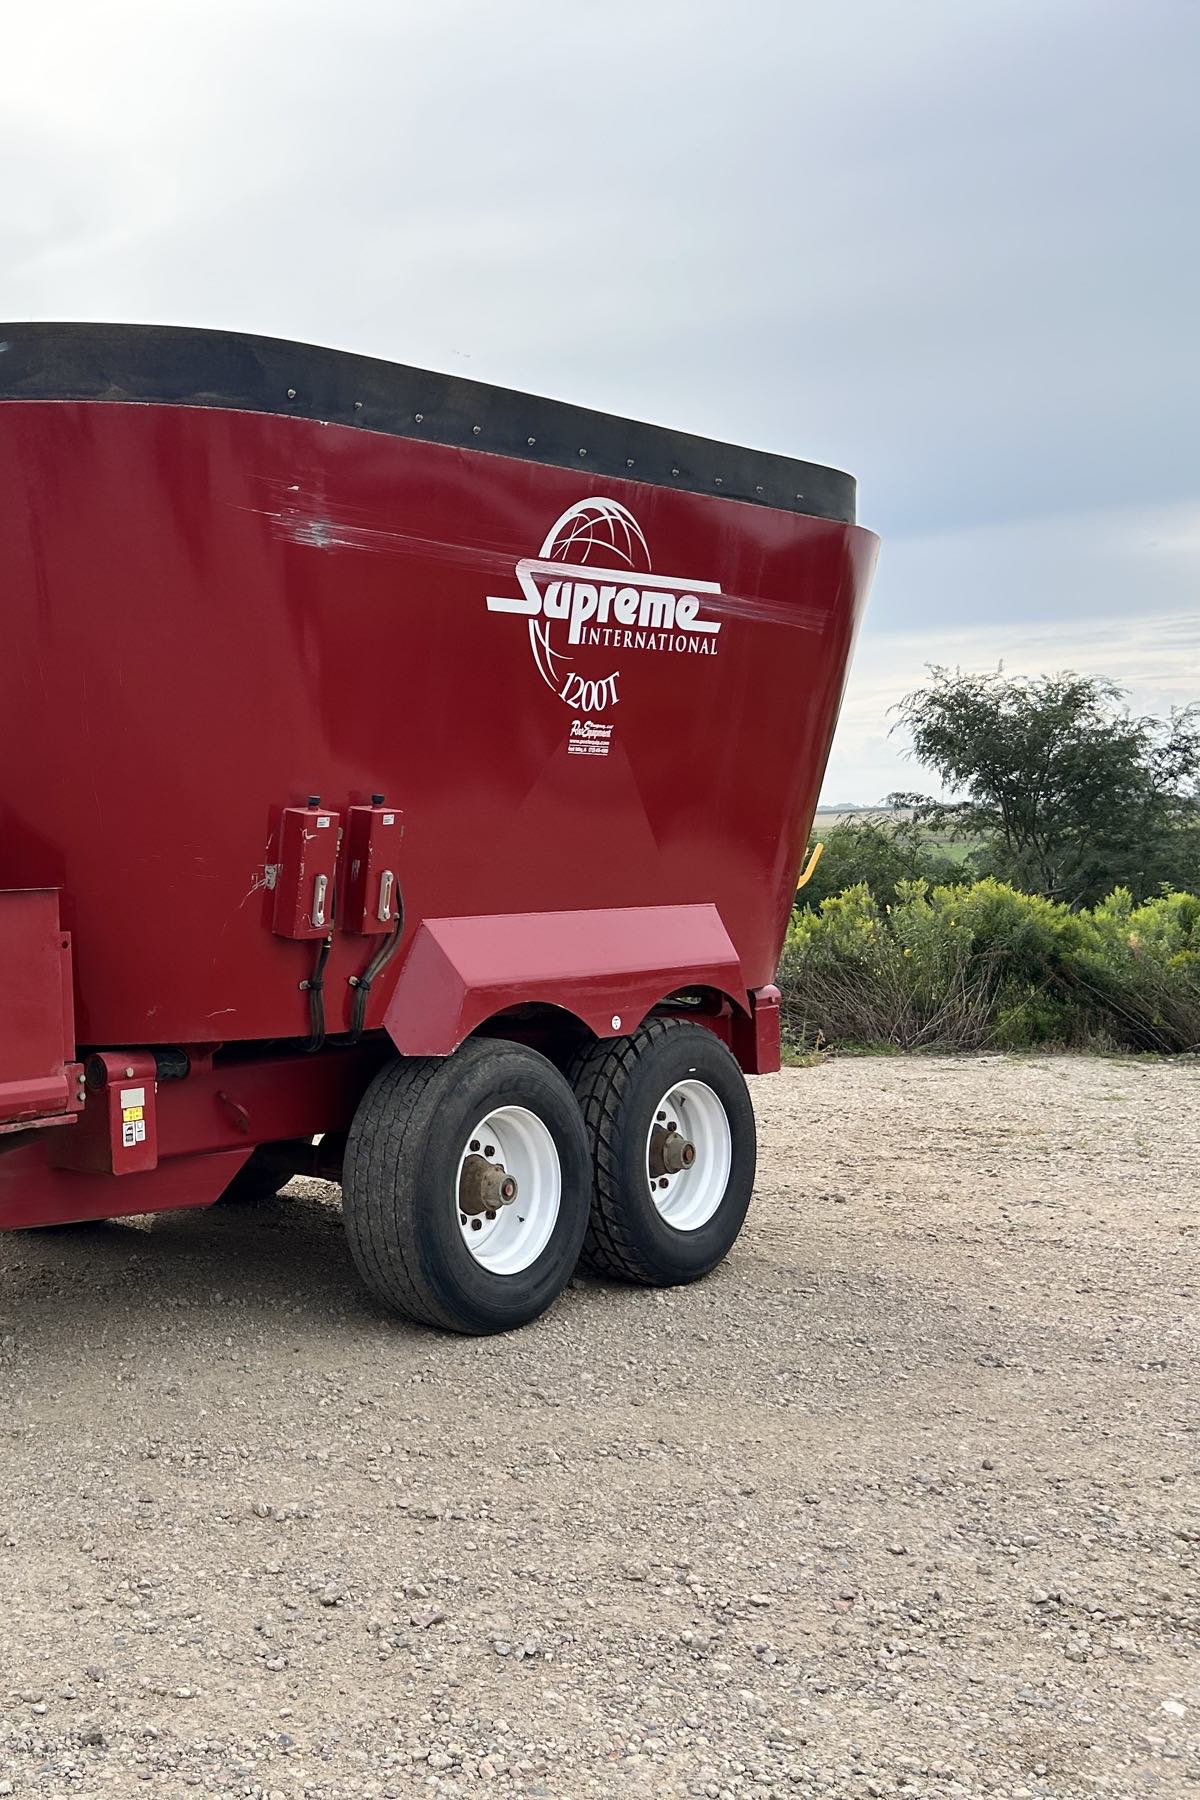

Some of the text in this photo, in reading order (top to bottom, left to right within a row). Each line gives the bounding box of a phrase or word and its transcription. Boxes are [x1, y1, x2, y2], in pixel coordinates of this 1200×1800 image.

[486, 559, 722, 645] Supreme
[581, 626, 718, 655] INTERNATIONAL
[558, 670, 620, 712] 1200T
